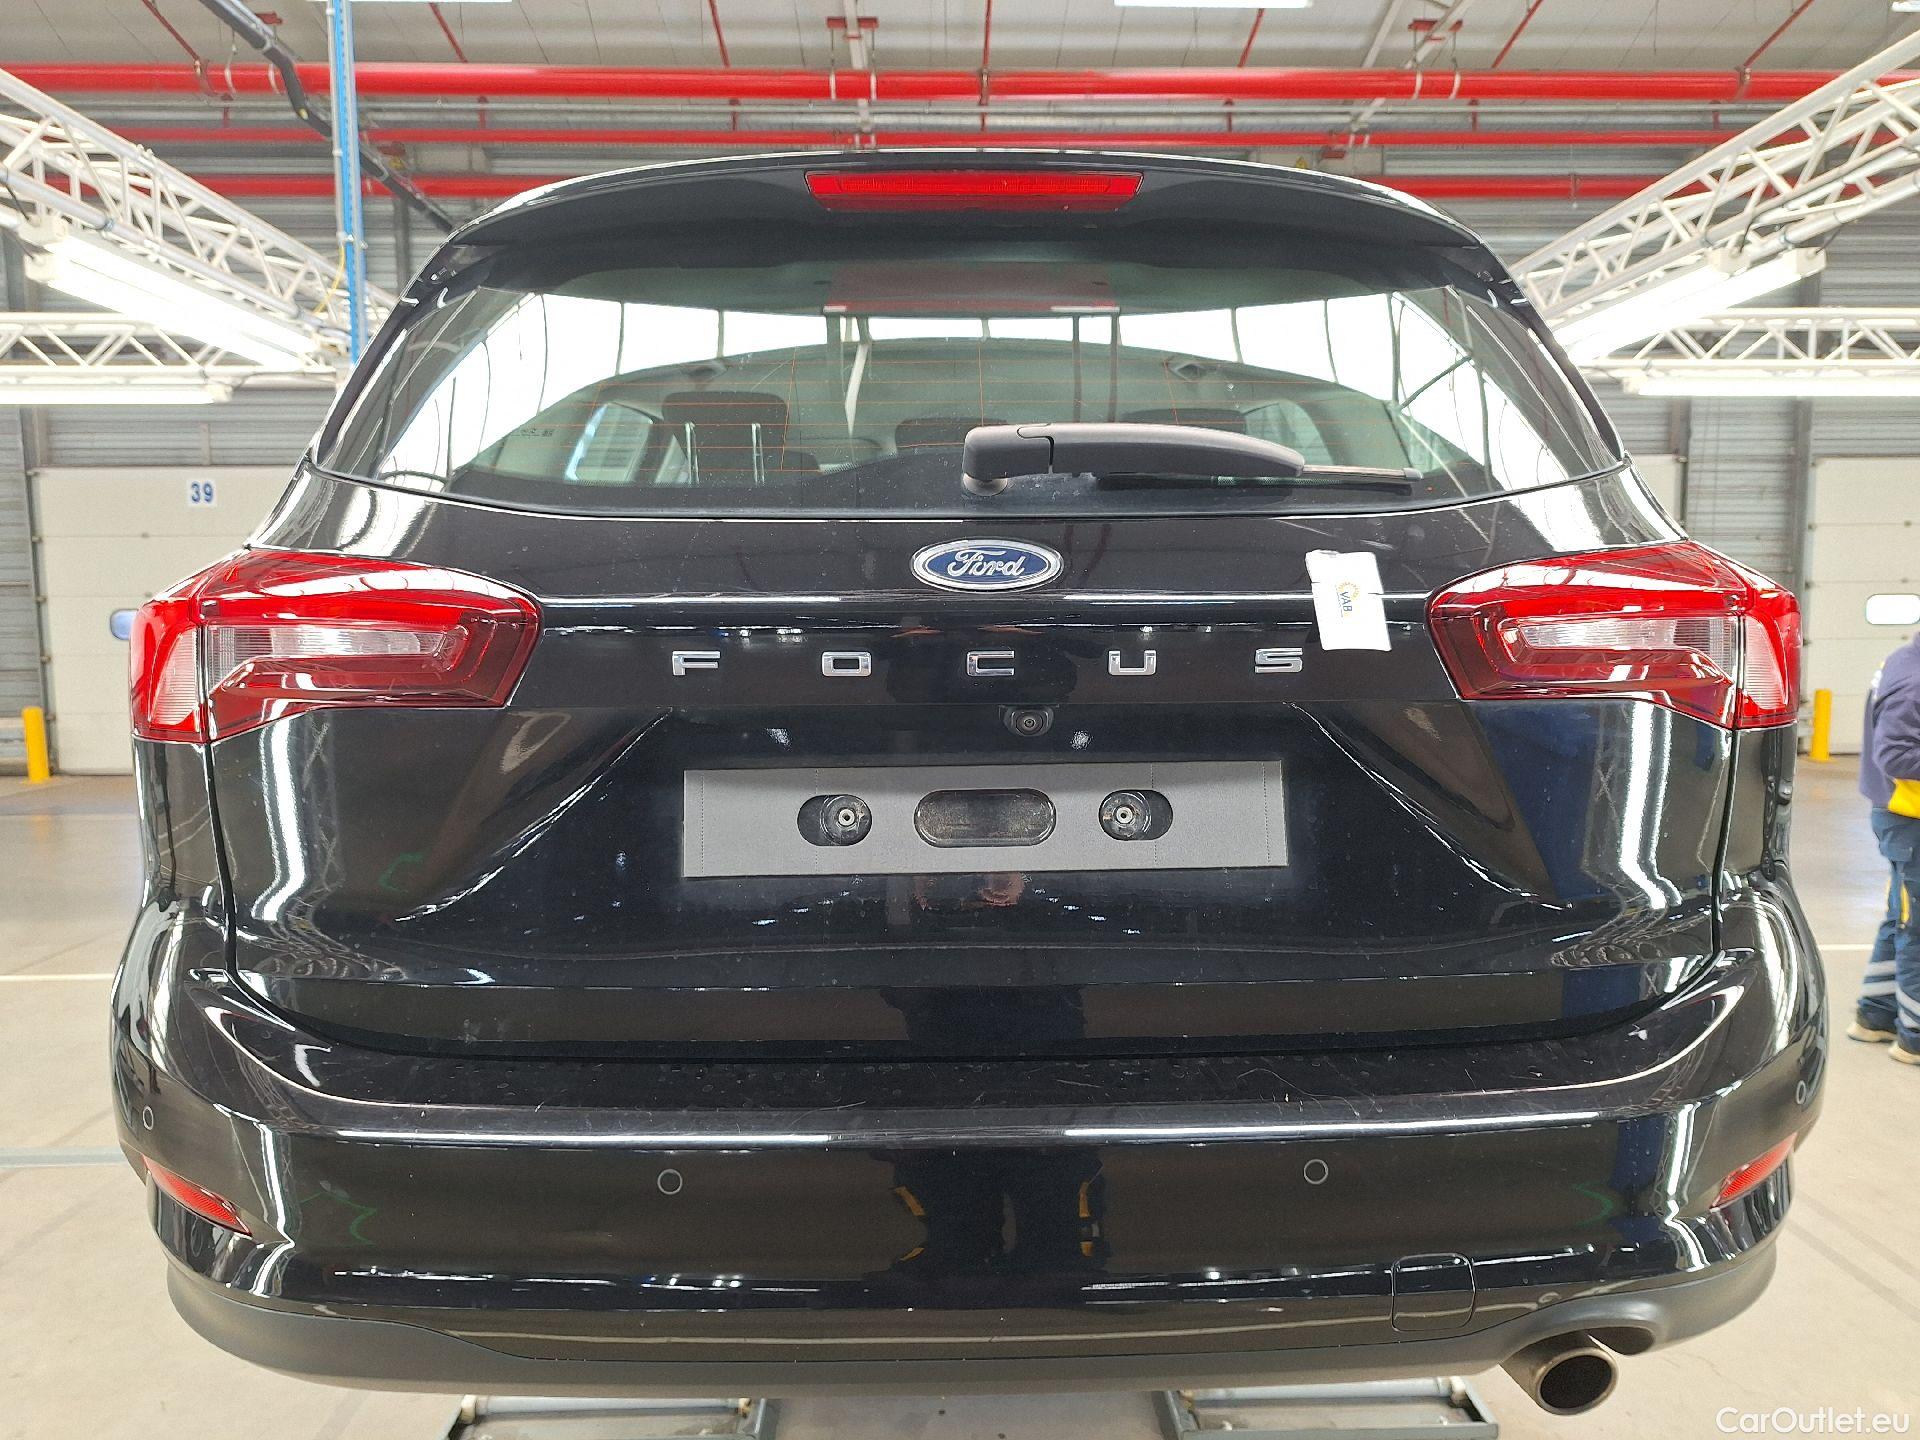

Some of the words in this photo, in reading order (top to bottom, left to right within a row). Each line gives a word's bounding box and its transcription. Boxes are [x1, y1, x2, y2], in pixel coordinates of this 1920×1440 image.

[191, 482, 213, 503] 39
[947, 549, 1025, 576] Ford
[1340, 591, 1352, 612] VAB
[672, 648, 1303, 676] FOCUS
